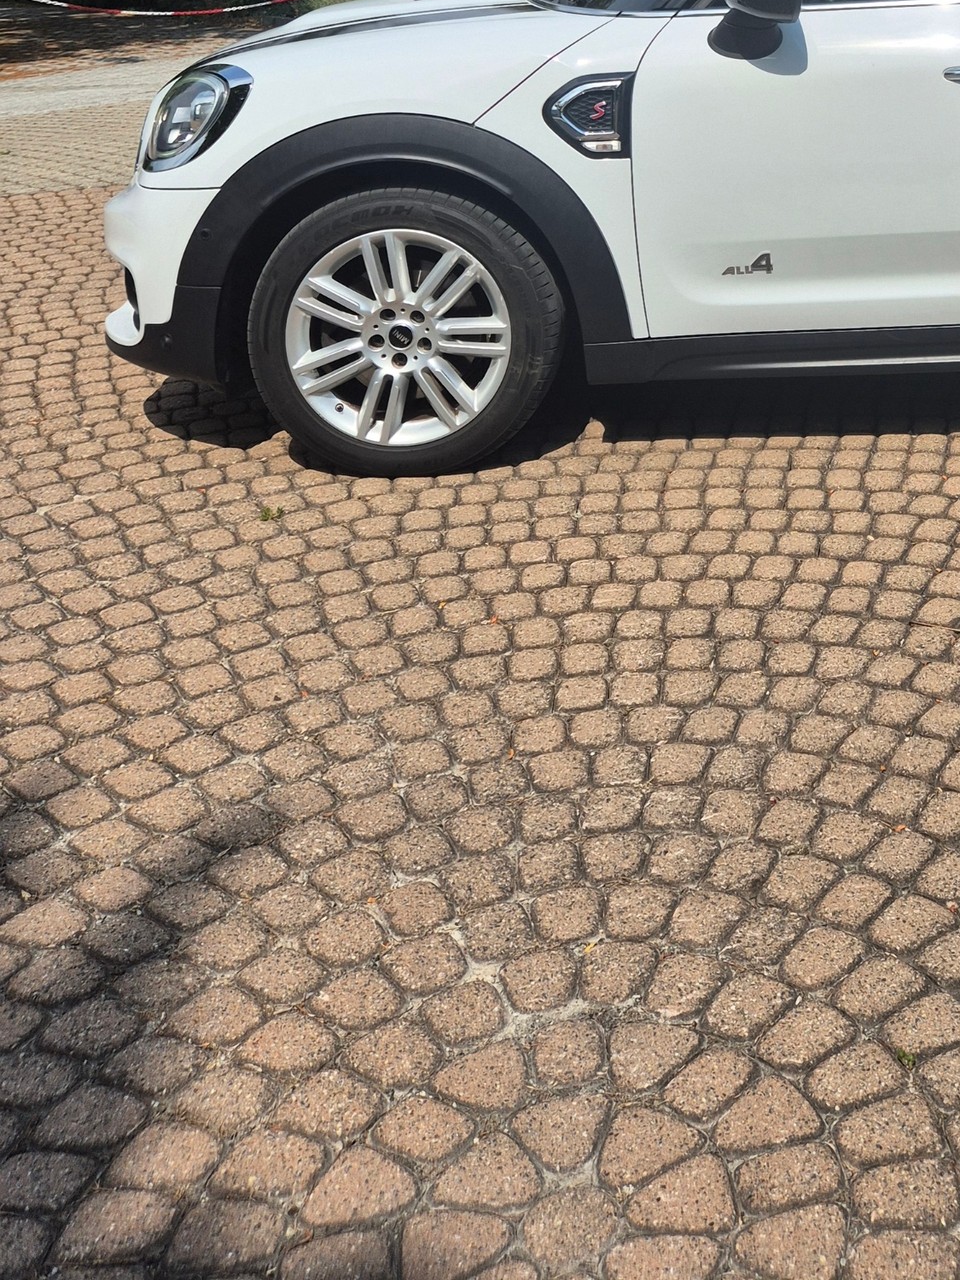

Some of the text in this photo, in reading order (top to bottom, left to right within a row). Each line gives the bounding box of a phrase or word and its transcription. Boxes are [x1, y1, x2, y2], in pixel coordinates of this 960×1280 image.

[589, 100, 607, 120] S
[721, 252, 774, 276] ALL4
[392, 329, 410, 345] MINI
